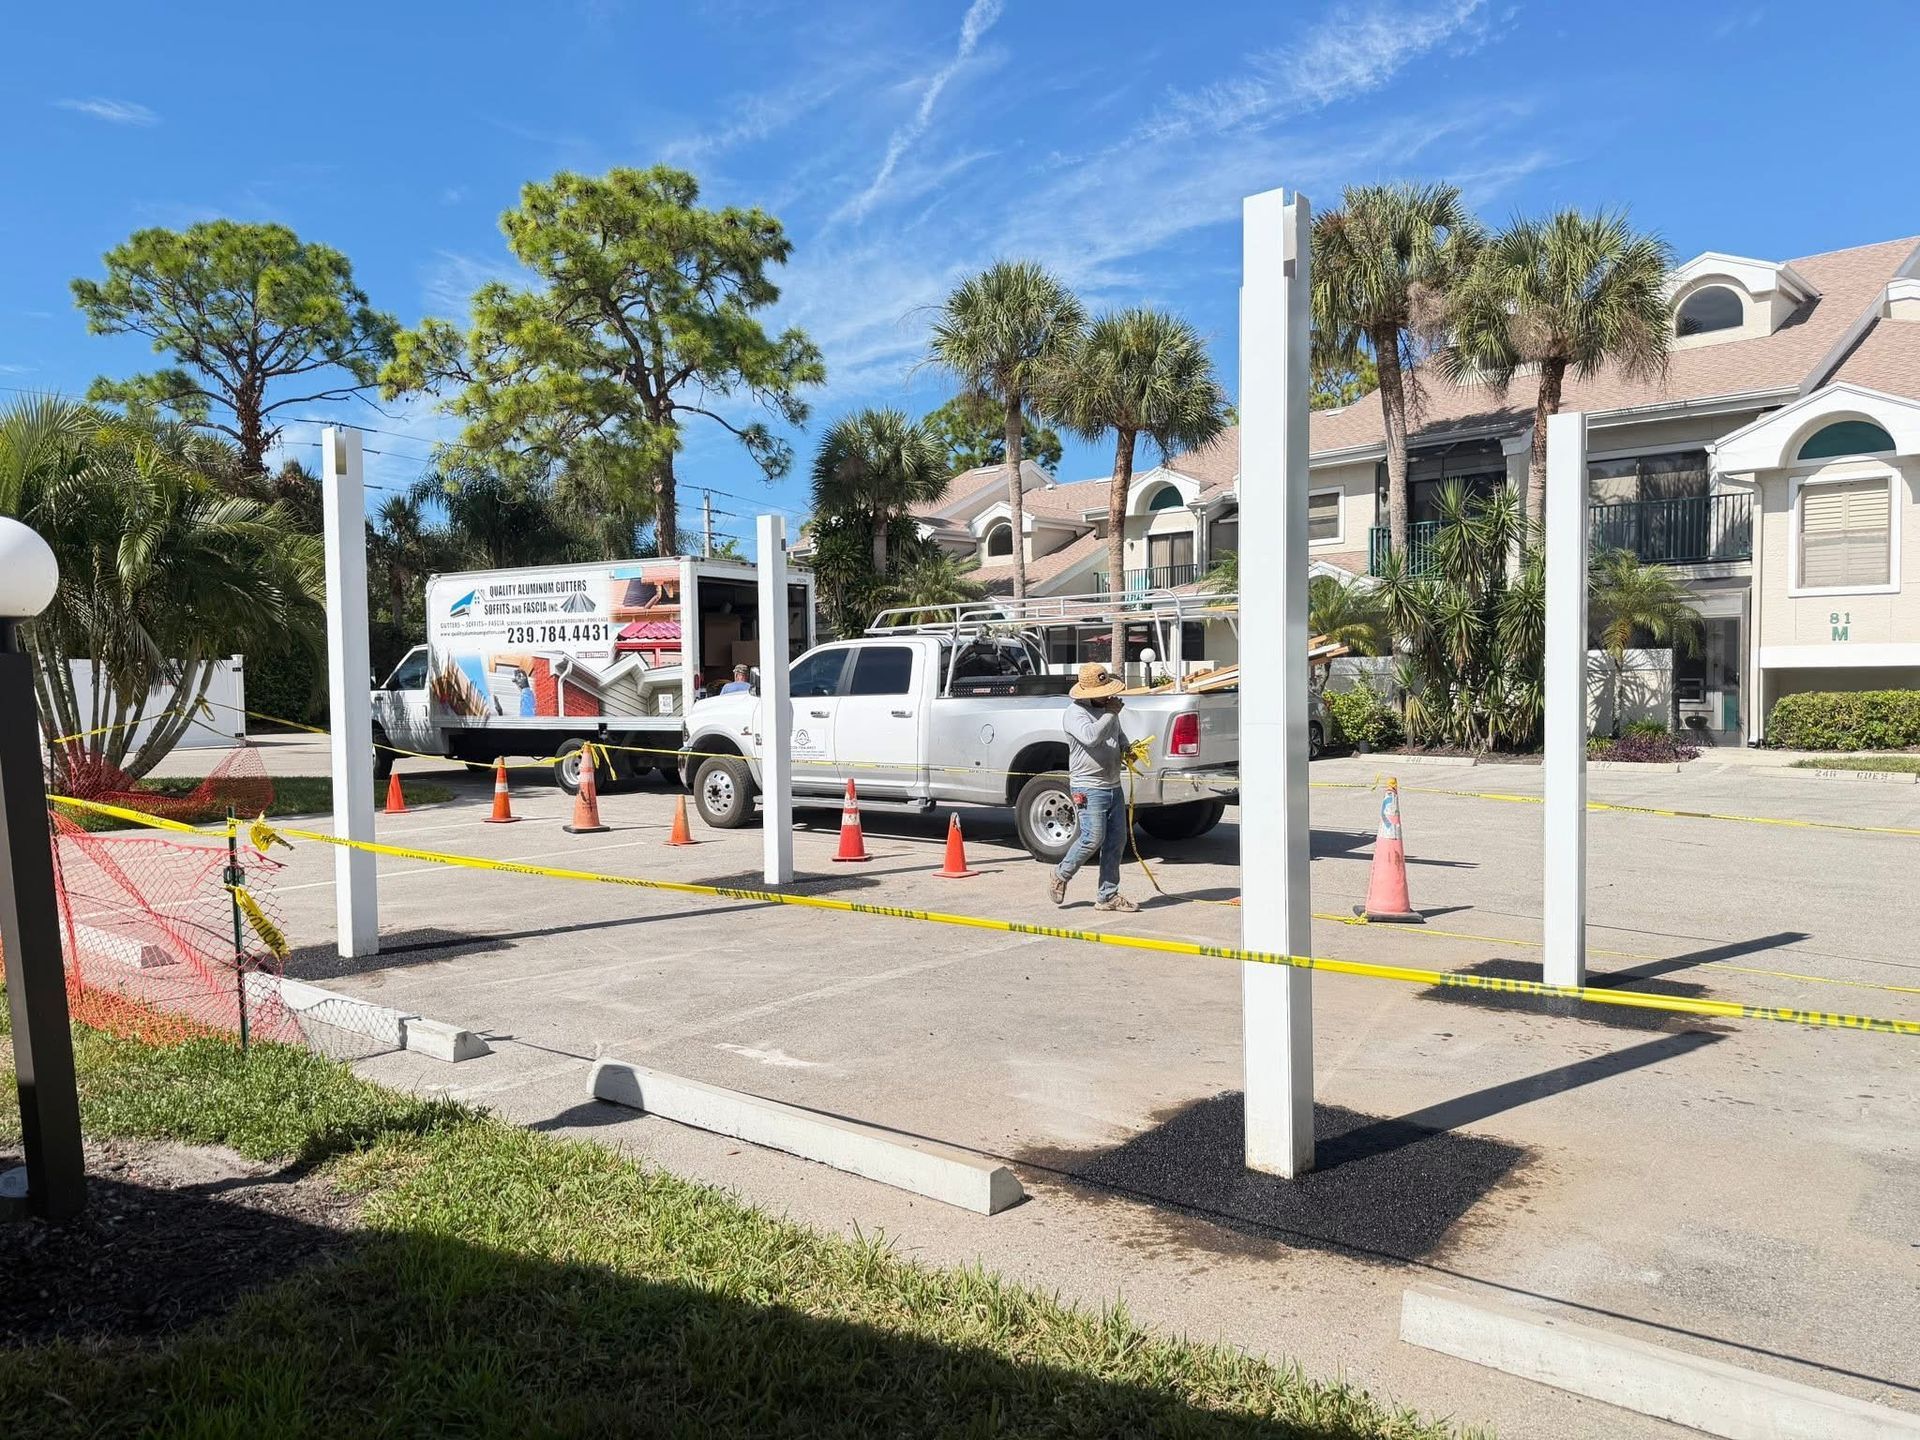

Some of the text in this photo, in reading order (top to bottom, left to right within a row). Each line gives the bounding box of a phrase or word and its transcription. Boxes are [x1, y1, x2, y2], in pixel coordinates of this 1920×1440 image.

[489, 584, 516, 598] QUALITY
[518, 582, 554, 595] ALUMINUM
[555, 580, 587, 593] GUTTERS
[484, 603, 510, 615] SOFFITS
[523, 601, 547, 614] FASCIA
[1830, 612, 1851, 624] 81
[507, 624, 609, 644] 239.784.4431
[1831, 626, 1848, 641] M
